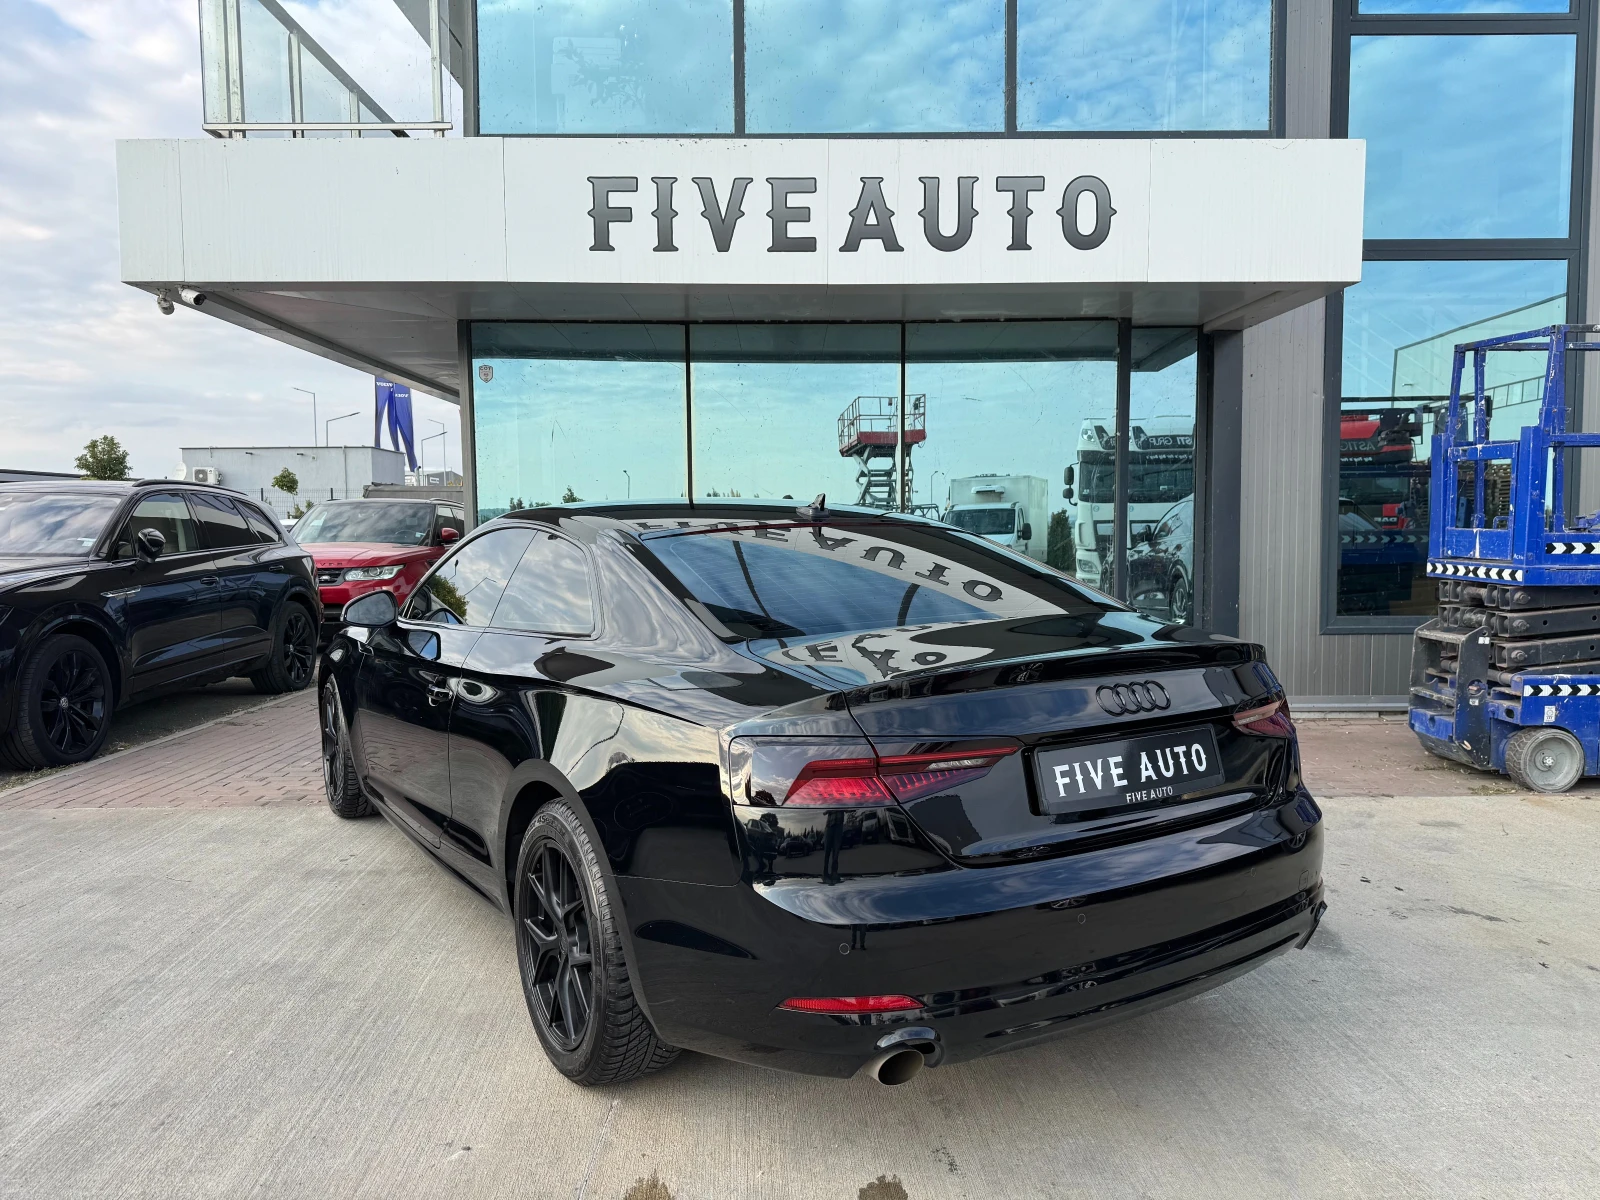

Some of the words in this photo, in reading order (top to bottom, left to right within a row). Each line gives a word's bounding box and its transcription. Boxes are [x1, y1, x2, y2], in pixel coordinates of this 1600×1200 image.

[1052, 755, 1129, 798] FIVE
[1139, 743, 1207, 783] AUTO
[1125, 790, 1148, 803] FIVE
[1150, 786, 1173, 799] AUTO
